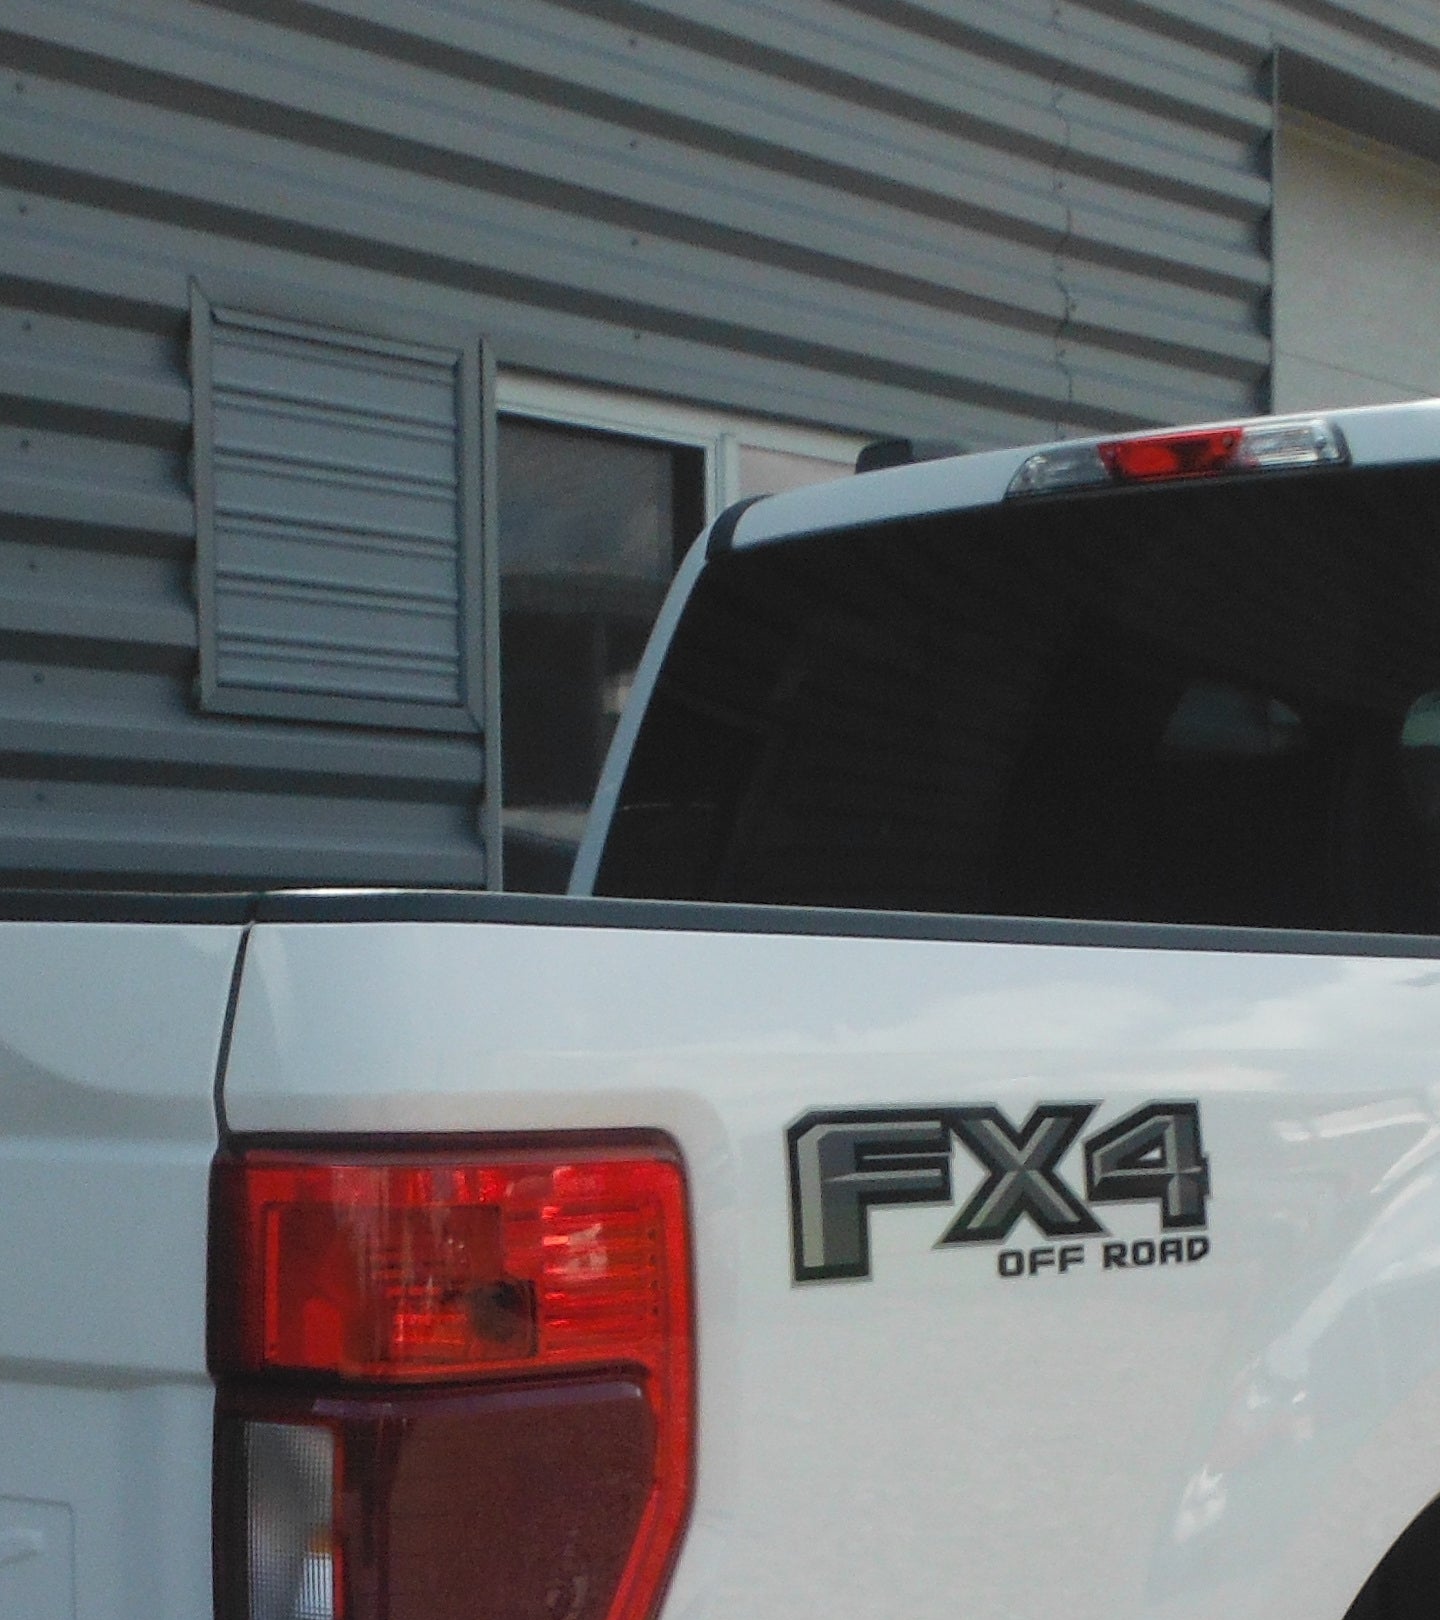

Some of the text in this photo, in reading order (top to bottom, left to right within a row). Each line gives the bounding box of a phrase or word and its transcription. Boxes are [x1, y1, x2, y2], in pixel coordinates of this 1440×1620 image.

[783, 1098, 1211, 1288] FX4
[996, 1234, 1212, 1279] OFF ROAD
